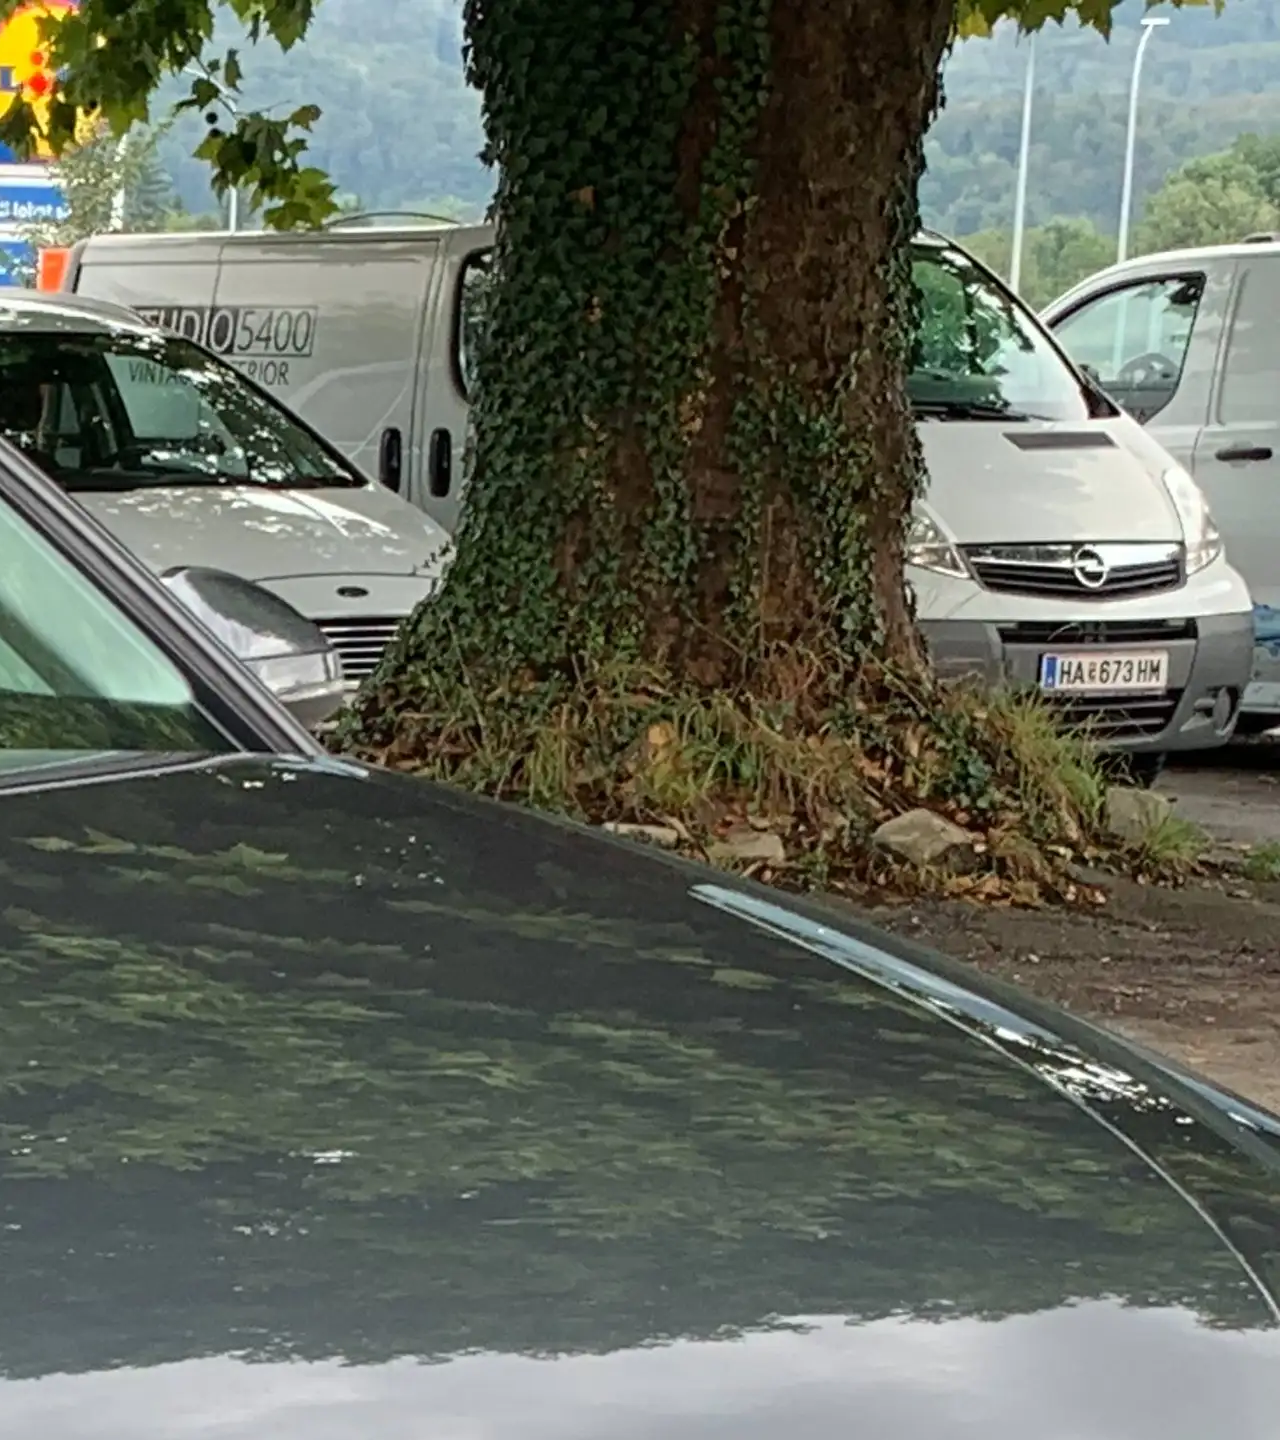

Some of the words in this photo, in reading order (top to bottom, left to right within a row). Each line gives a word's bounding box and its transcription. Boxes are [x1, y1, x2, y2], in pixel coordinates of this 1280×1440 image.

[1060, 660, 1085, 684] HA
[1099, 659, 1134, 684] 673
[1136, 658, 1161, 682] HM
